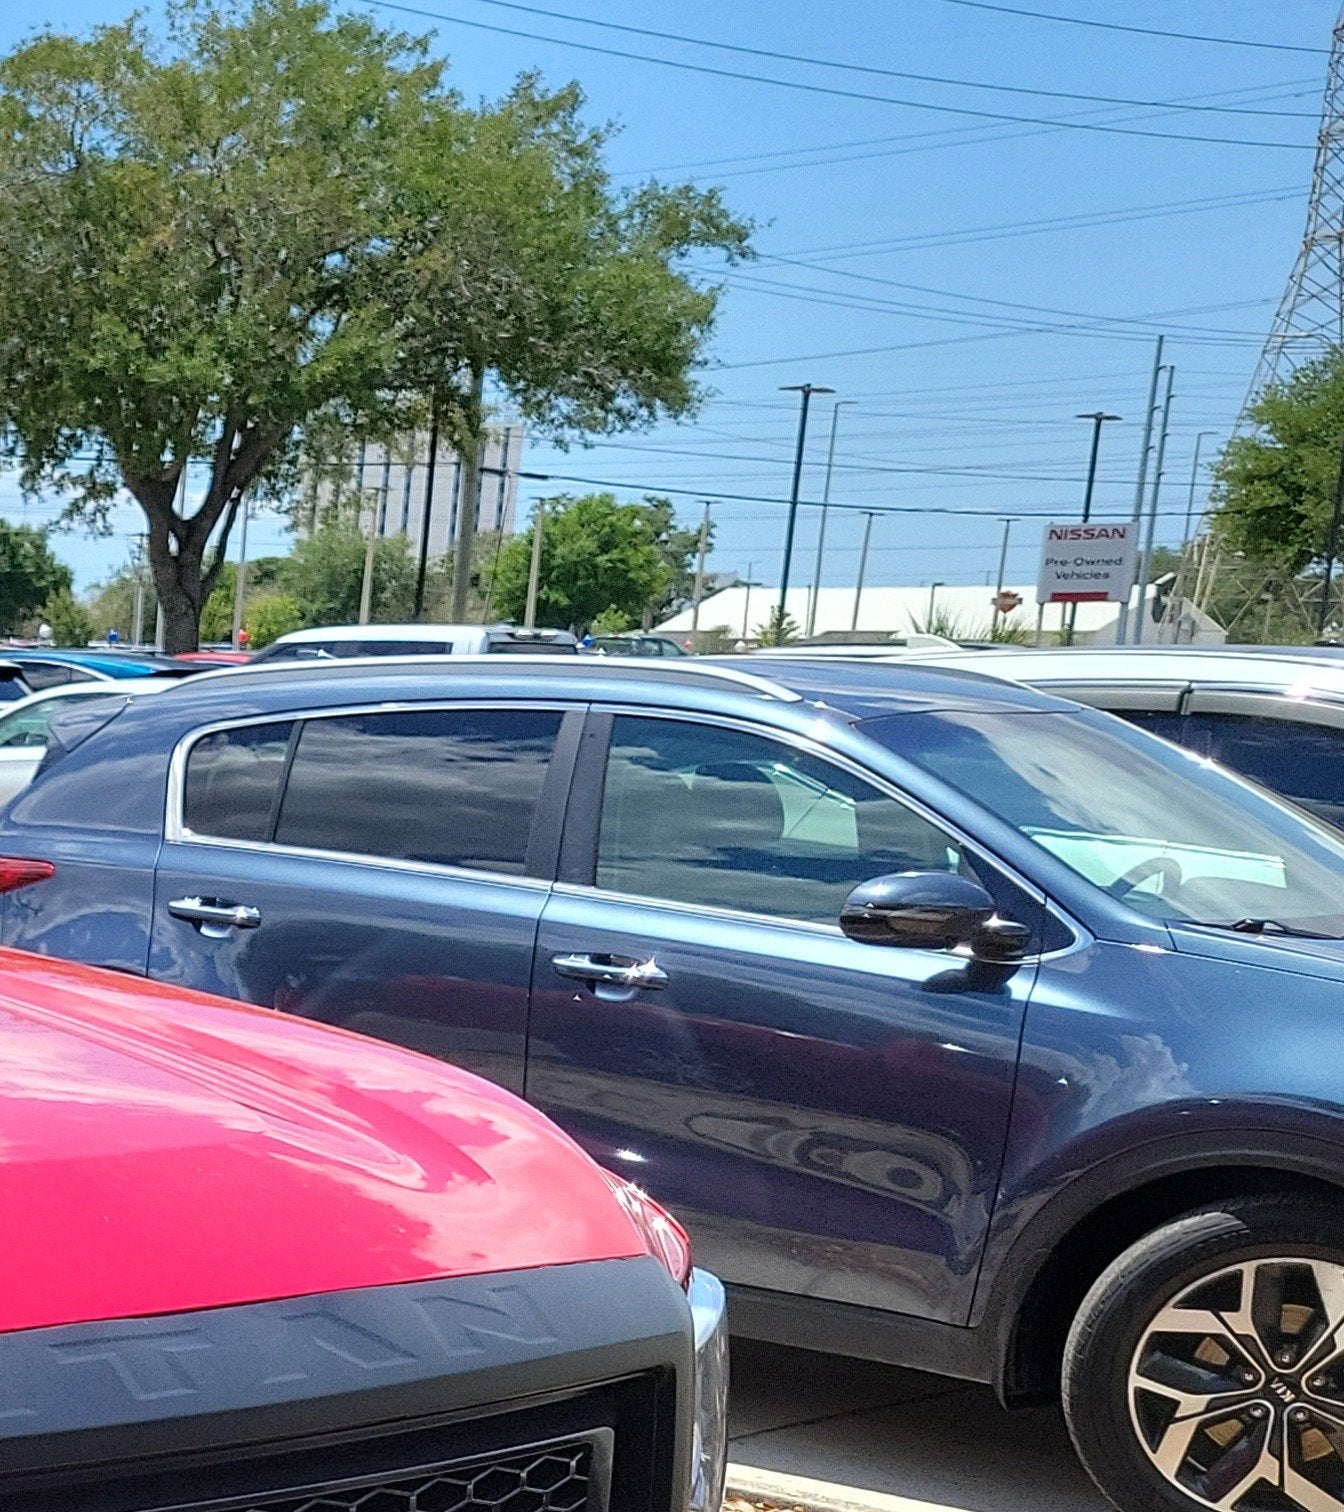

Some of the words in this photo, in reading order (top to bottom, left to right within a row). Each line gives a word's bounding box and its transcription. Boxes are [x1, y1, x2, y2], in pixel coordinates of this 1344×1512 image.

[1048, 527, 1127, 540] NISSAN
[1045, 556, 1124, 567] Pre-Owned
[1055, 570, 1111, 580] Vehicles
